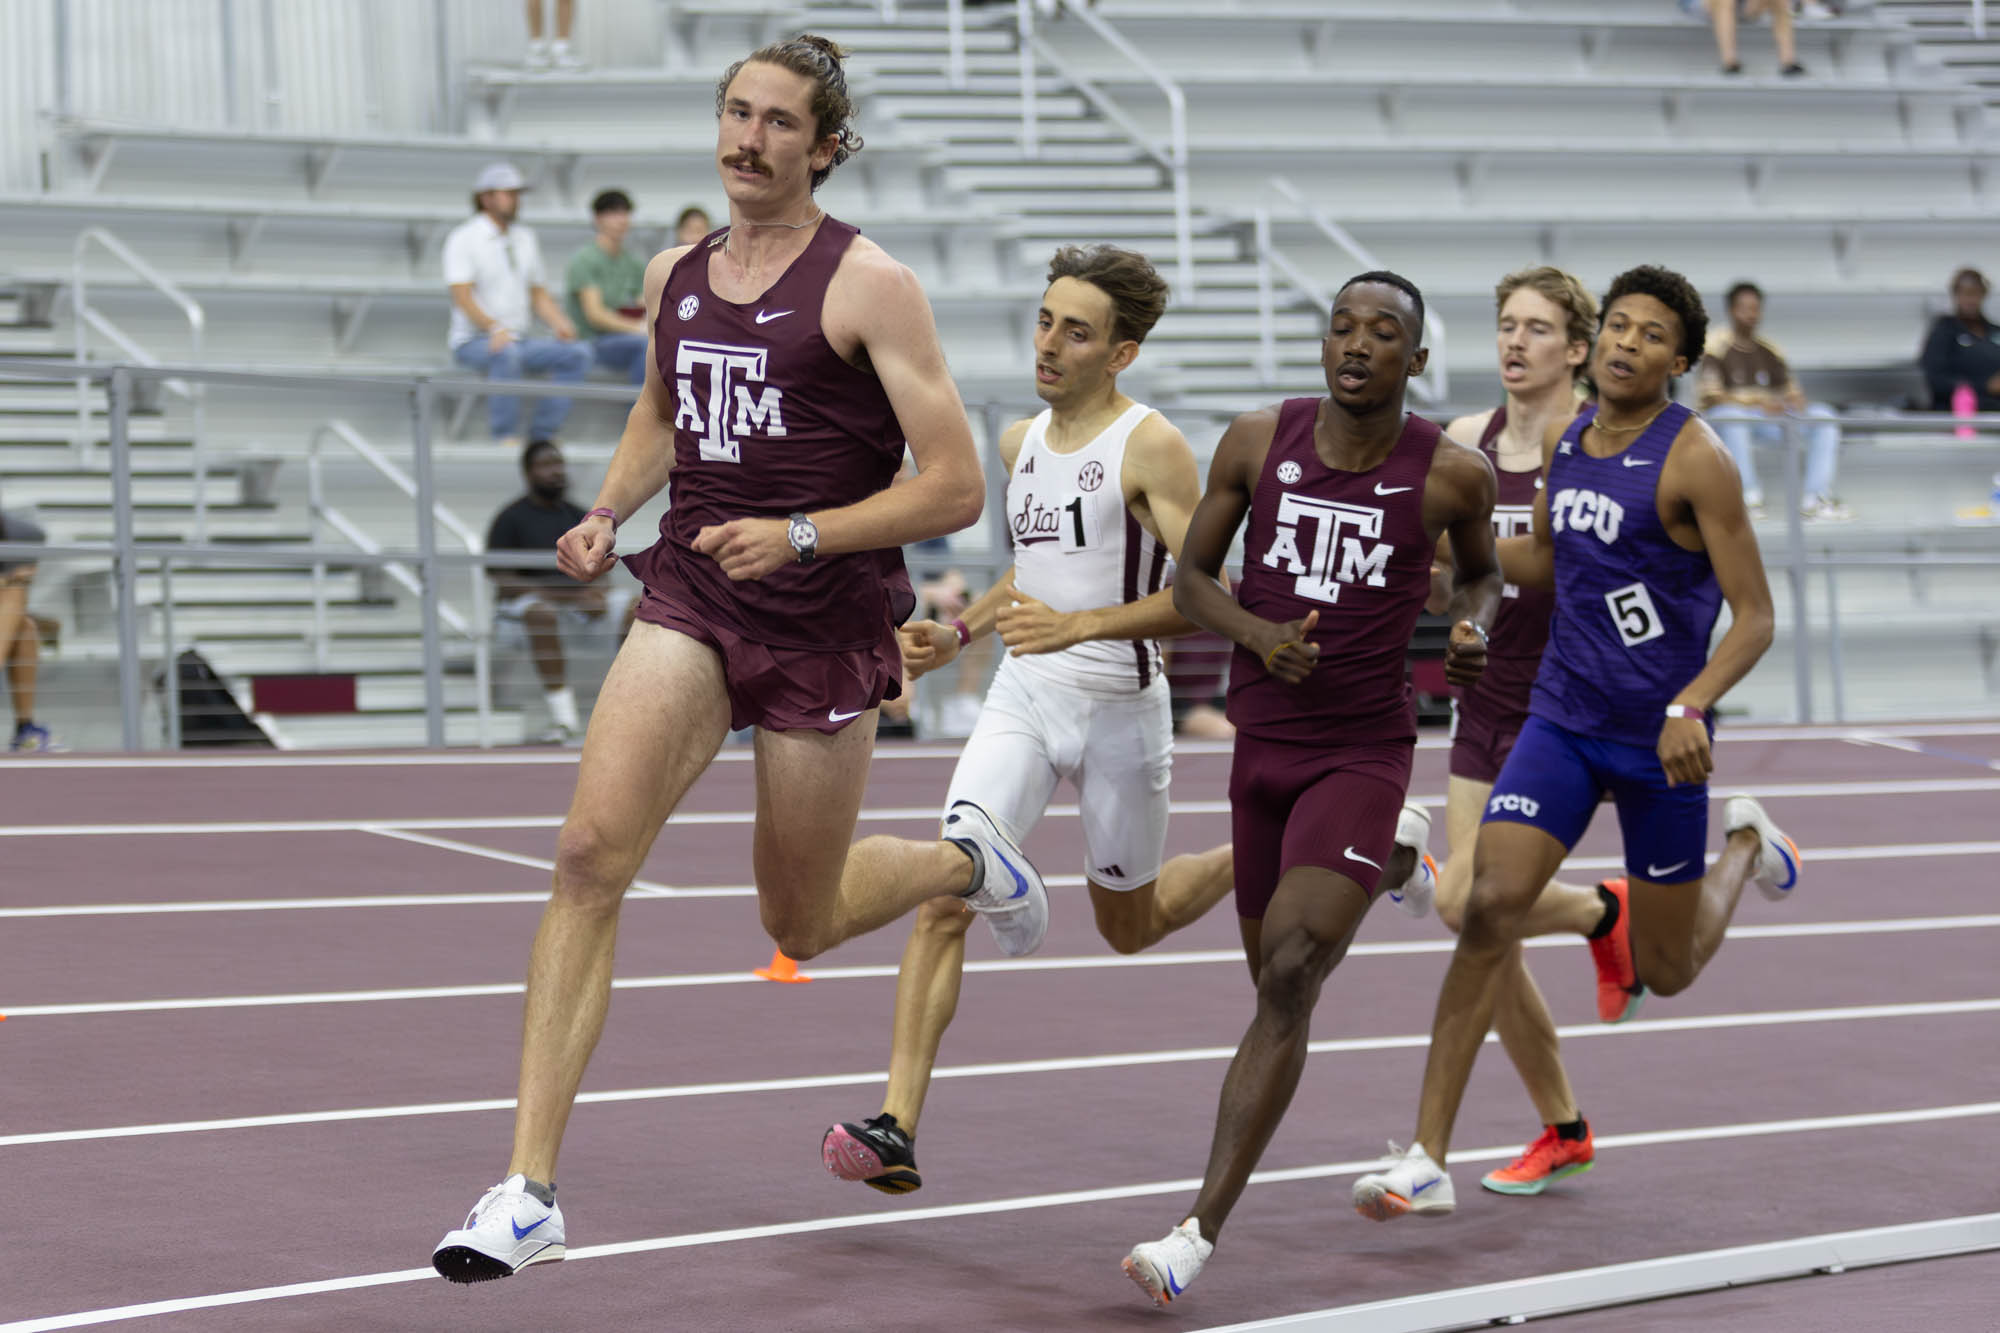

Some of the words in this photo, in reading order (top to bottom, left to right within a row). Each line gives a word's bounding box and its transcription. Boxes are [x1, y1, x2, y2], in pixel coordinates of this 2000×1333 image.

[1065, 496, 1086, 548] 1
[1552, 488, 1625, 545] TCU
[1612, 591, 1651, 639] 5
[1489, 794, 1540, 818] TCU
